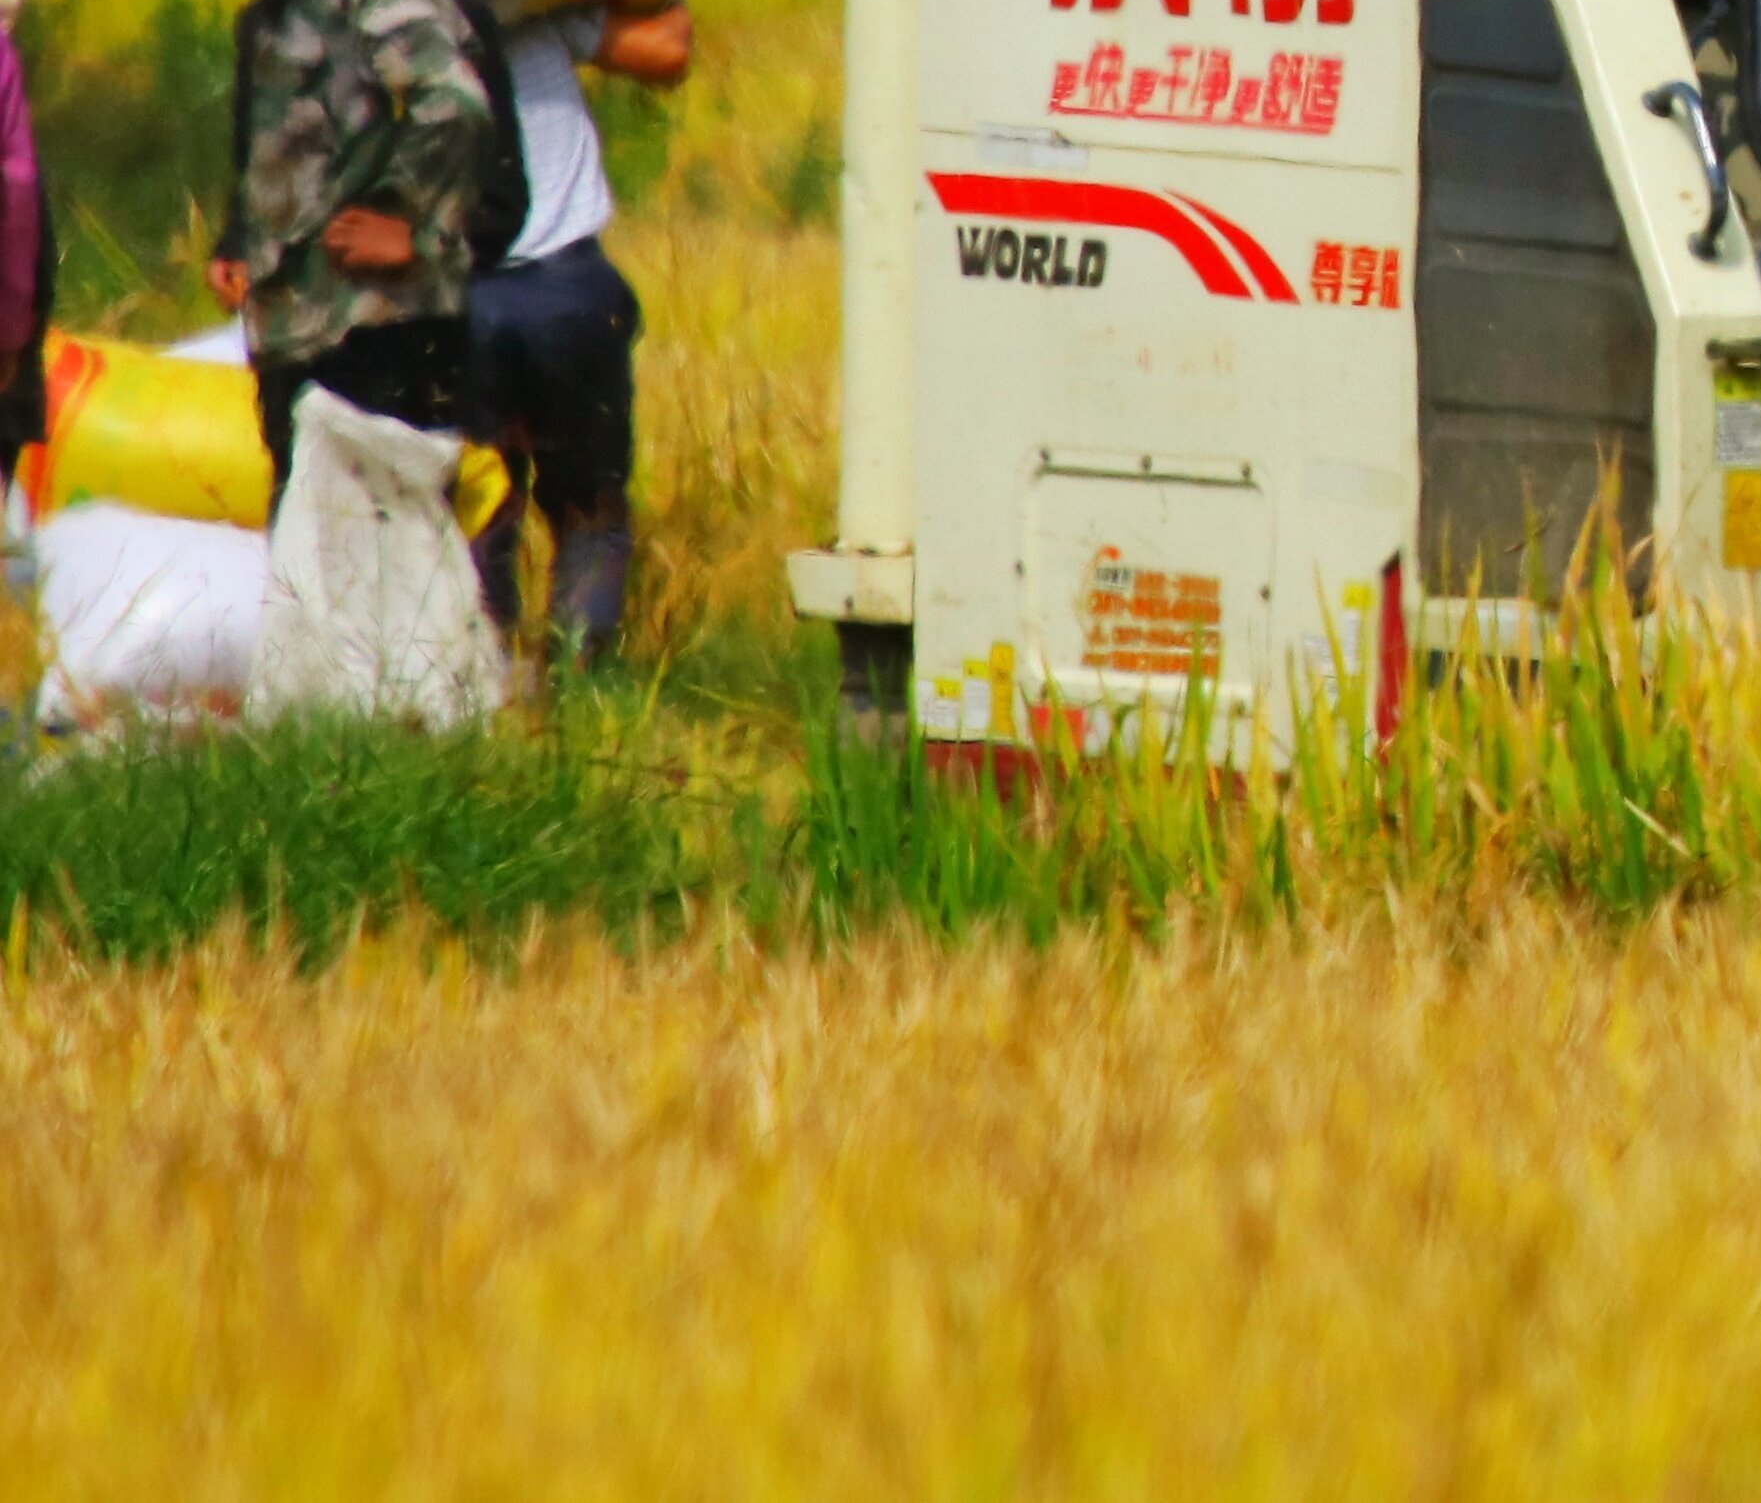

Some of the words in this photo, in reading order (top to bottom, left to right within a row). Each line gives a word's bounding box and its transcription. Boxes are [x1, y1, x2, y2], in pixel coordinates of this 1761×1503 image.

[1047, 40, 1343, 135] 更快更干净更舒适
[956, 225, 1108, 288] WORLD
